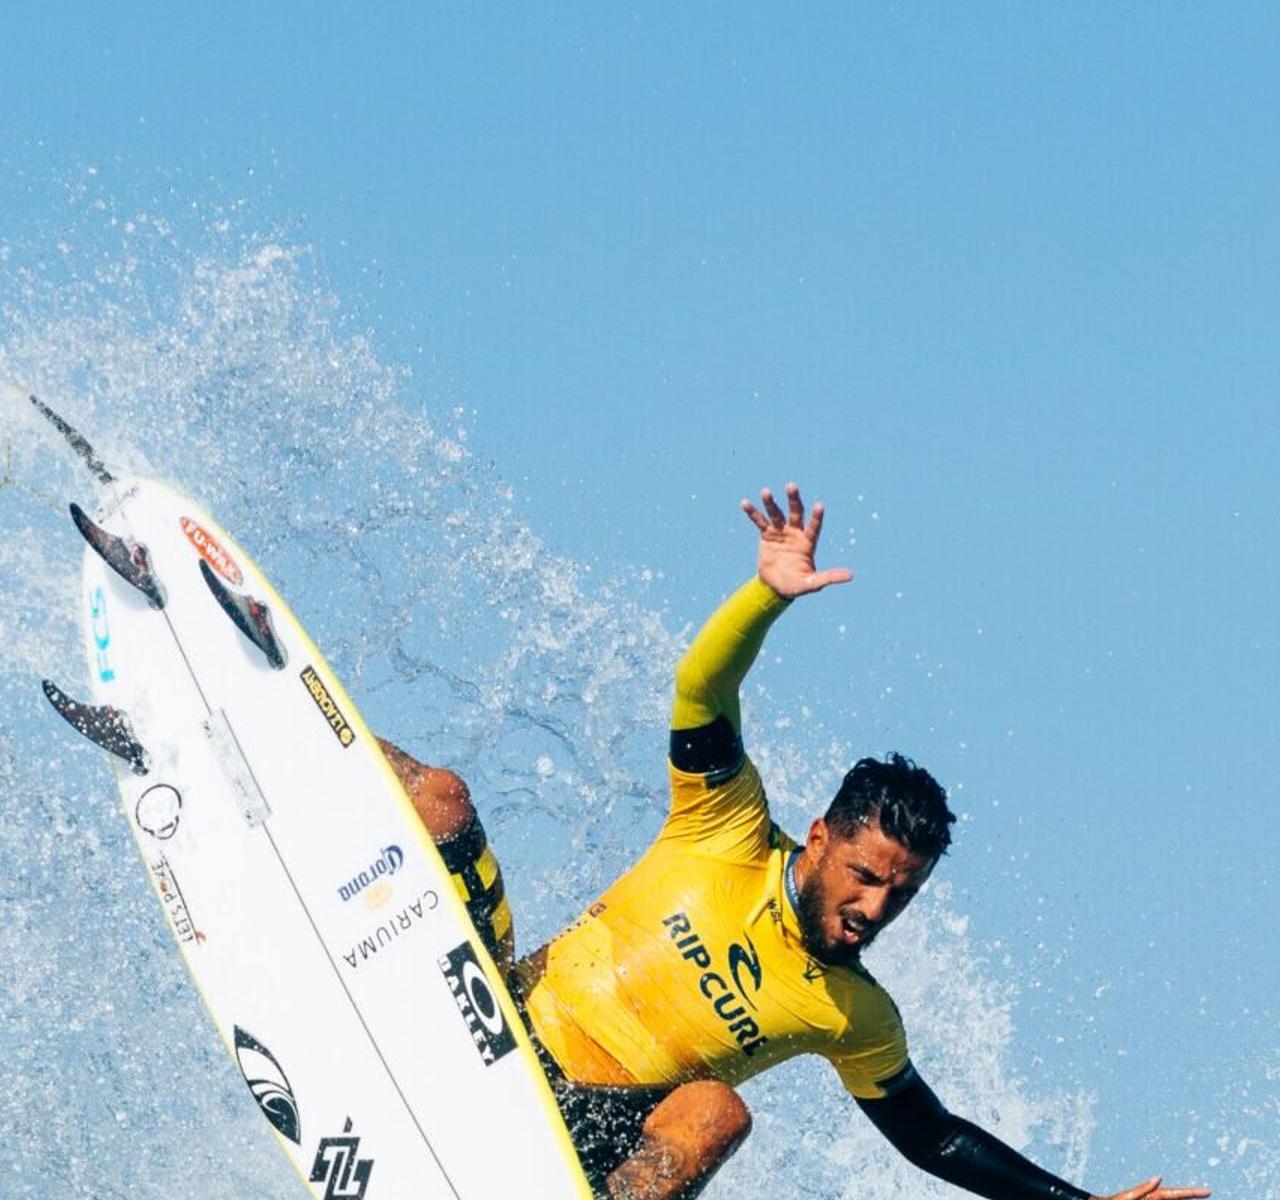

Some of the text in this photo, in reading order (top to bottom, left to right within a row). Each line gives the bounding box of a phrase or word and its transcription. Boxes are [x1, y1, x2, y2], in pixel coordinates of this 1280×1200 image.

[302, 670, 338, 718] ACADEMY
[337, 845, 404, 901] Corona
[342, 890, 438, 969] CARIUMA
[437, 955, 496, 1060] OAKLEY
